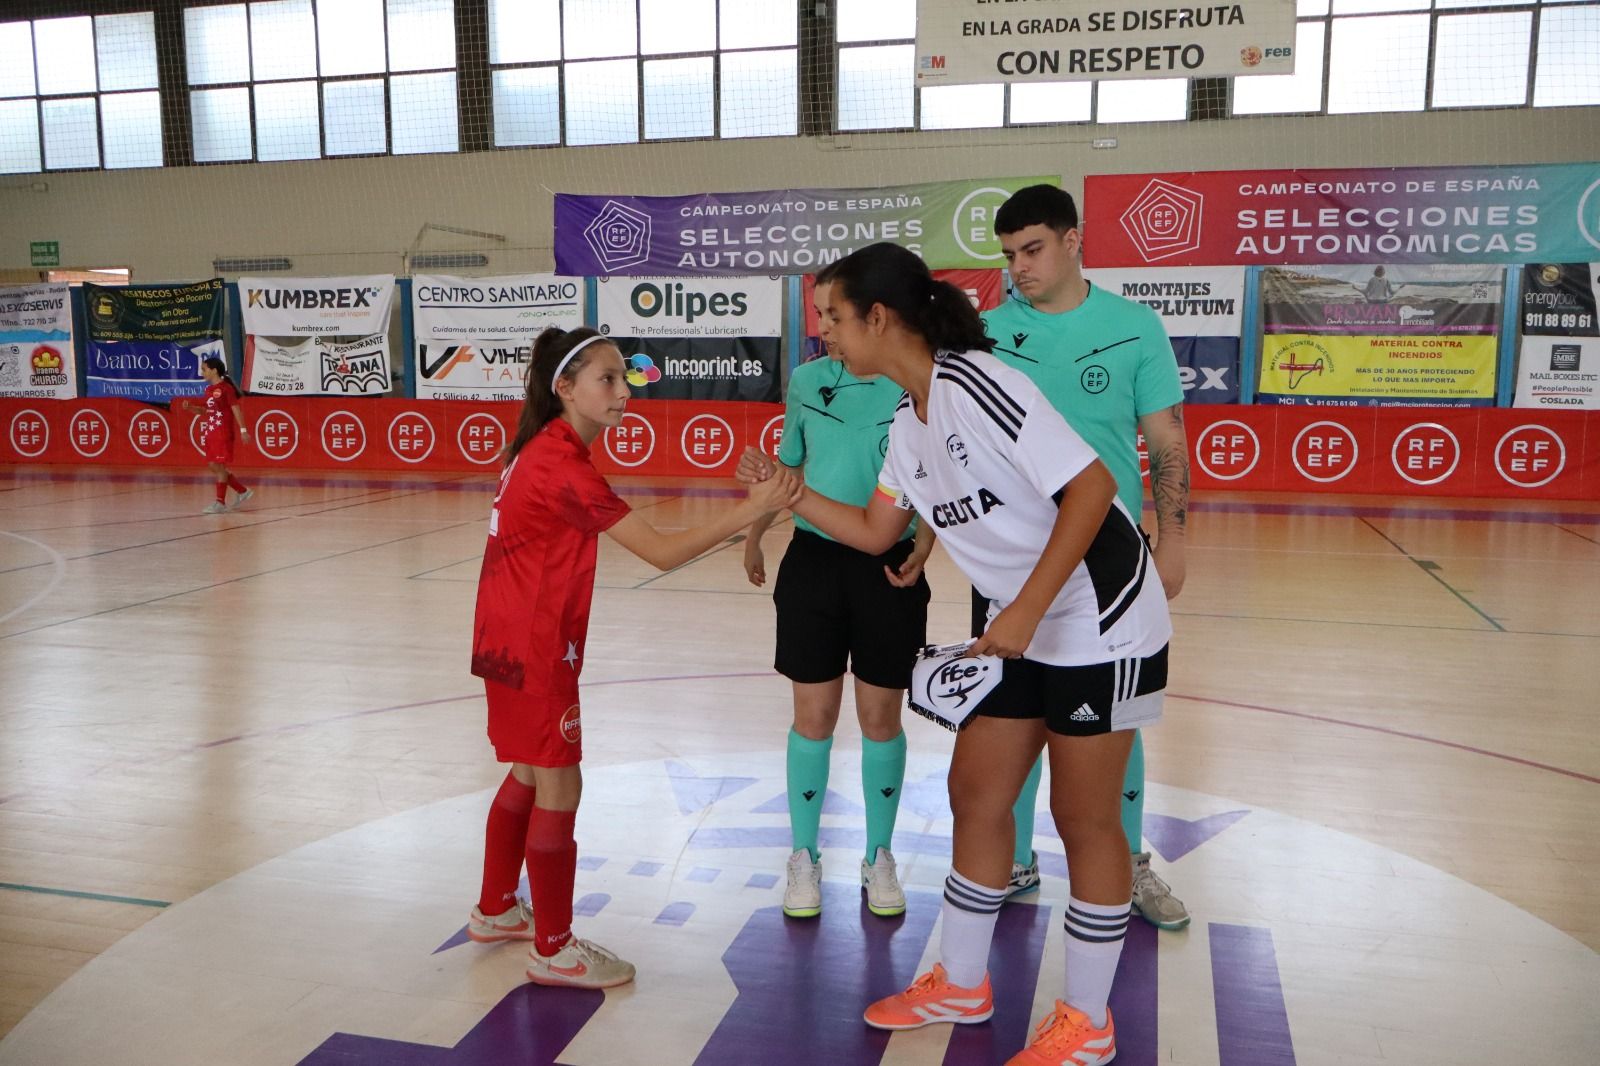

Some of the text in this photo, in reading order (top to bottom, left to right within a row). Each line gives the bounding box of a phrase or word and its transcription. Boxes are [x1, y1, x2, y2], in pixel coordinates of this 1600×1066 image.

[963, 5, 1245, 36] EN LA GRADA SE DISFRUTA
[997, 44, 1204, 76] CON RESPETO
[1239, 176, 1540, 196] CAMPEONATO DE ESPAÑA
[680, 194, 923, 217] CAMPEONATO DE ESPAÑA
[1237, 205, 1538, 229] SELECCIONES
[680, 219, 923, 246] SELECCIONES
[1235, 228, 1537, 255] AUTONÓMICAS
[247, 288, 370, 309] KUMBREX
[418, 283, 577, 303] CENTRO SANITARIO
[1122, 282, 1211, 299] MONTAJES
[630, 282, 748, 323] Olipes
[1135, 299, 1235, 316] PLUTUM
[631, 326, 645, 335] The
[705, 325, 747, 335] Lubricants
[1526, 313, 1592, 328] 911 88 89 61
[1422, 340, 1463, 348] CONTRA
[159, 350, 192, 369] S.L.
[480, 346, 532, 365] VIHE
[1388, 351, 1442, 359] INCENDIOS
[325, 358, 380, 374] TRANA
[665, 356, 763, 378] incoprint.es
[31, 374, 67, 385] CHURROS
[1178, 367, 1229, 391] ex
[1530, 372, 1553, 380] MAIL
[295, 382, 304, 390] 28
[1532, 385, 1593, 393] #PeoplePossible
[1540, 397, 1584, 405] COSLADA
[932, 487, 1006, 529] CEUTA
[1069, 713, 1100, 722] adidas
